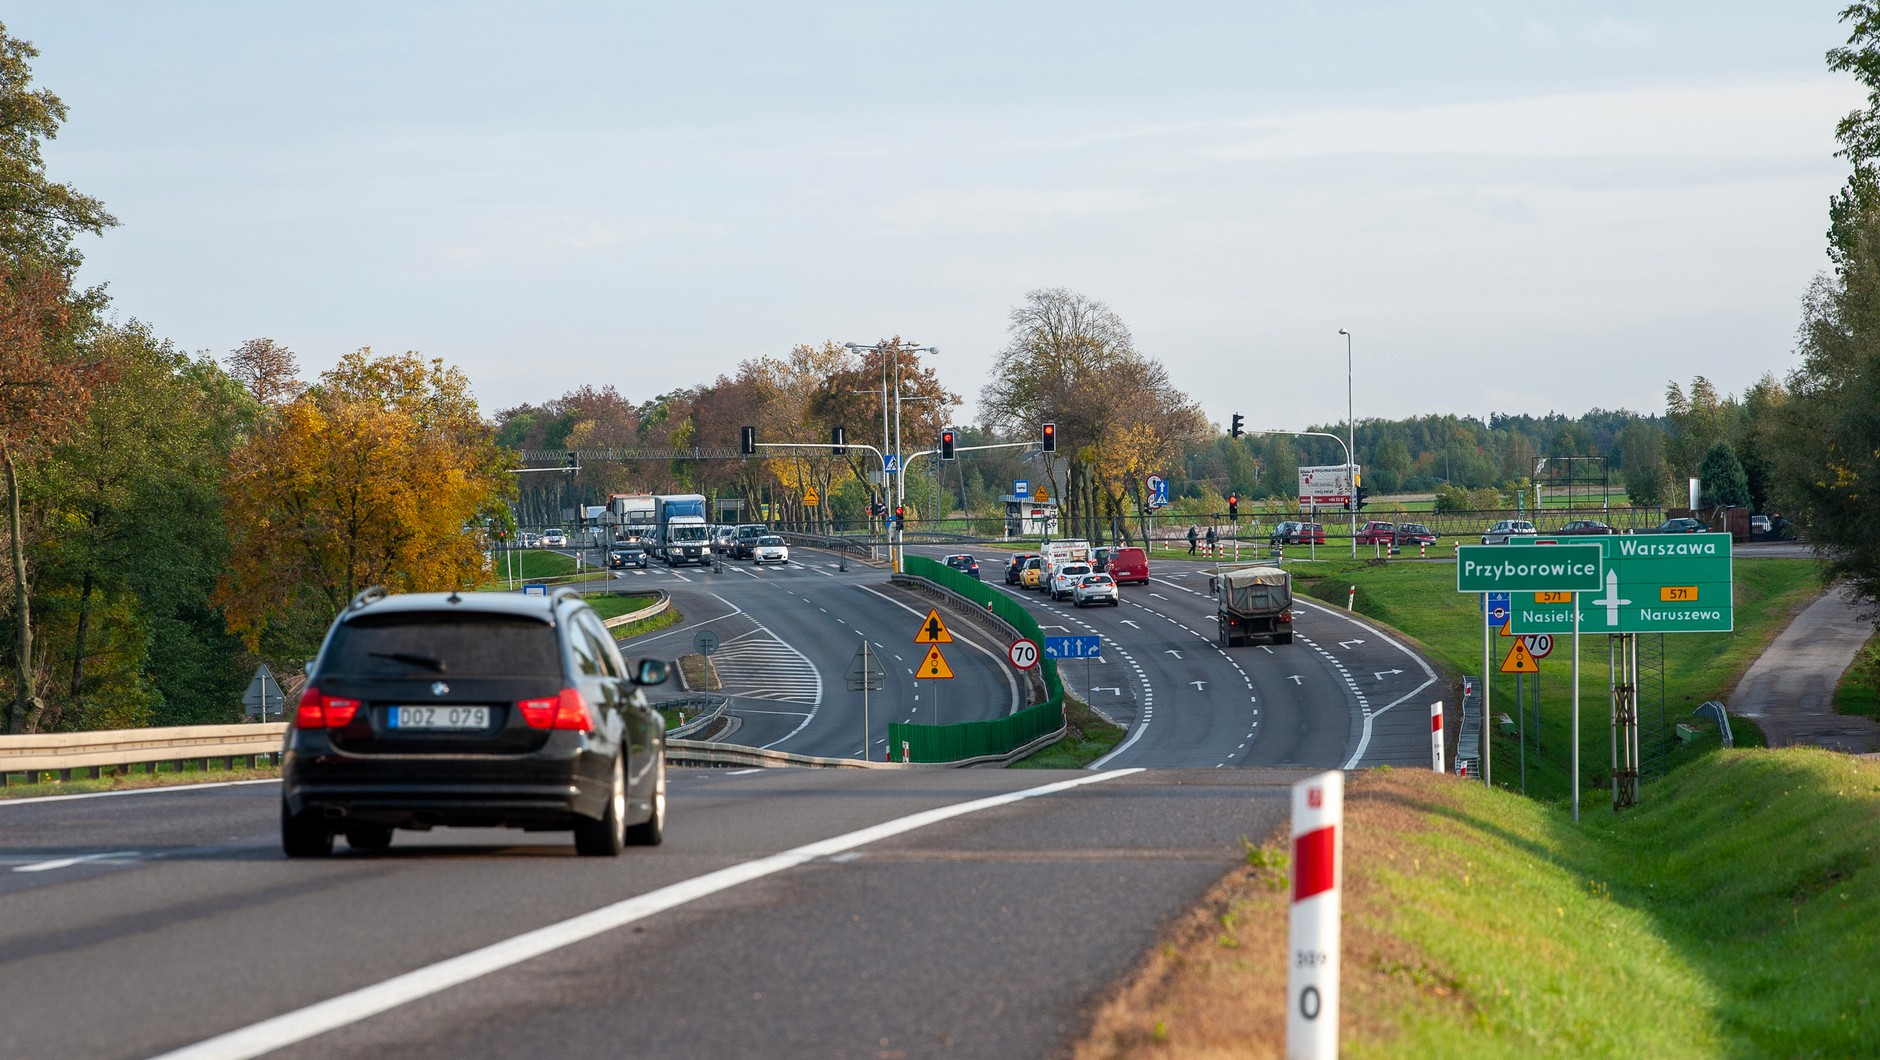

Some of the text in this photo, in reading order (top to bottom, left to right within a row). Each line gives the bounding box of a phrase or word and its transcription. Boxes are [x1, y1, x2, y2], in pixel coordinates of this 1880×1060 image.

[1620, 541, 1715, 556] Warszawa
[1465, 560, 1595, 581] Przyborowice
[1544, 592, 1561, 601] 571
[1670, 588, 1688, 599] 571
[1641, 609, 1720, 621] Naruszewo
[1528, 636, 1549, 651] 70
[1015, 647, 1035, 661] 70
[448, 707, 485, 725] 079
[1299, 985, 1320, 1020] 0
